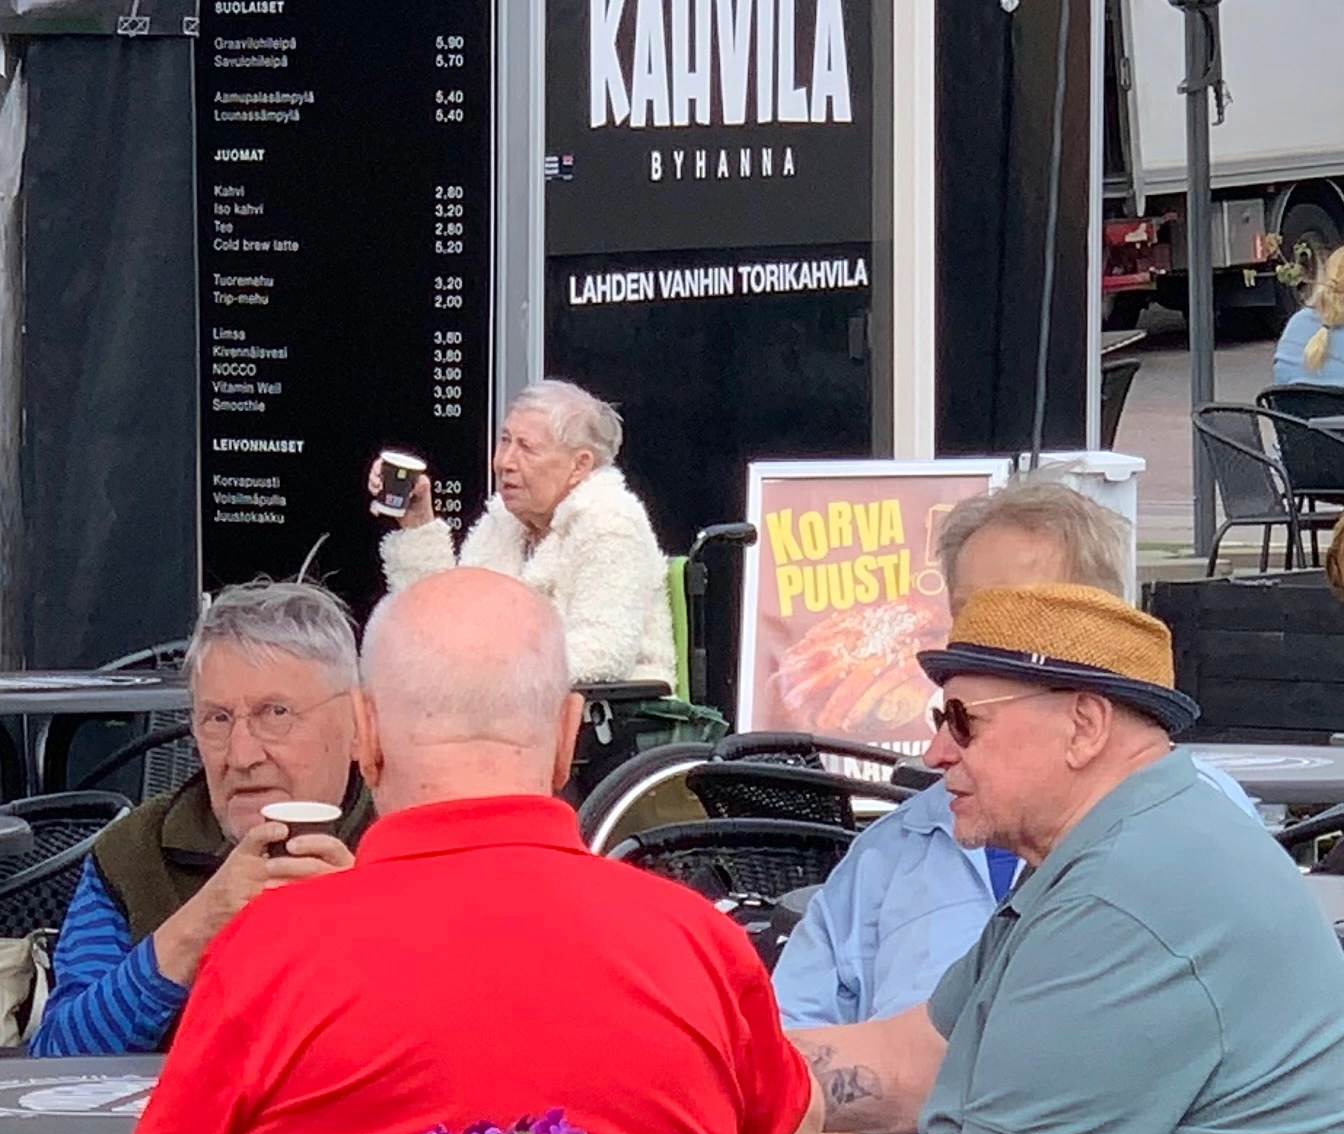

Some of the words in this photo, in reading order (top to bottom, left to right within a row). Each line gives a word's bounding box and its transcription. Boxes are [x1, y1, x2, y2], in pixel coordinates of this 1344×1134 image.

[215, 1, 285, 14] SUOLAISET
[590, 0, 853, 128] KAHVILA
[436, 90, 464, 105] 5,40
[214, 148, 265, 161] JUOMAT
[214, 185, 245, 197] Kahvi
[214, 203, 231, 215] Iso
[234, 202, 264, 215] kahvi
[435, 204, 463, 218] 3,20
[214, 220, 233, 234] Tee
[213, 238, 239, 251] Cold
[243, 239, 270, 252] brew
[434, 276, 463, 290] 3,20
[569, 271, 654, 305] LAHDEN
[659, 267, 734, 299] VANHIN
[738, 258, 869, 294] TORIKAHVILA
[434, 295, 463, 309] 2,00
[212, 363, 257, 376] NOCCO
[212, 381, 254, 394] Vitamin
[212, 398, 266, 412] Smoothie
[213, 438, 304, 453] LEIVONNAISET
[434, 480, 462, 494] 3,20
[766, 499, 905, 566] KORVA
[776, 548, 911, 617] PUUSTI
